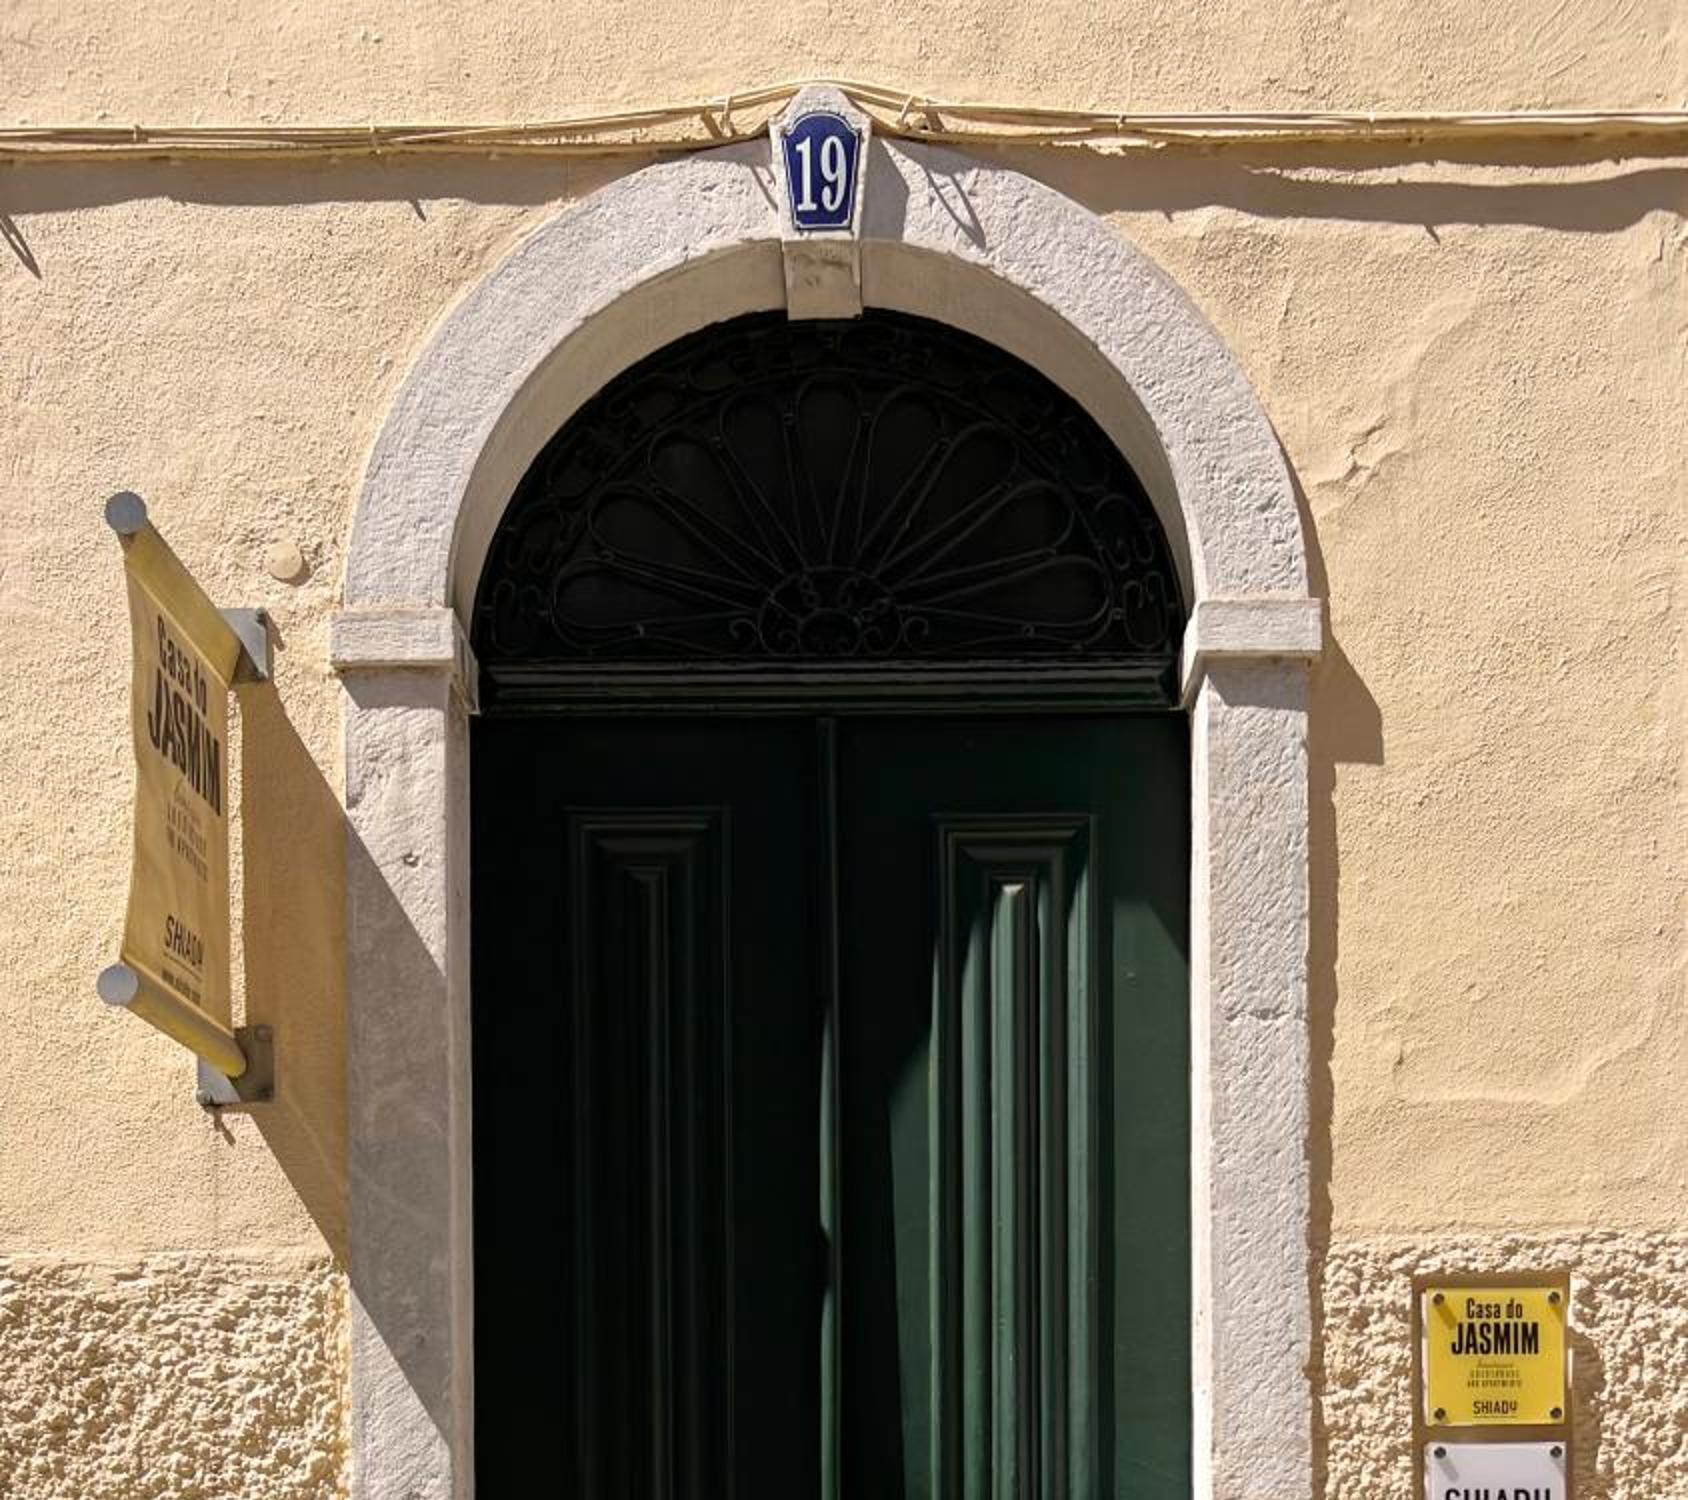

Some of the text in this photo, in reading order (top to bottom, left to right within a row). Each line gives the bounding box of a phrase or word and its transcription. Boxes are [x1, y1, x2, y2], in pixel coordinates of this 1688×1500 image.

[795, 135, 847, 212] 19
[158, 613, 192, 695] Casa
[148, 666, 221, 817] JASMIM
[1466, 1297, 1523, 1319] Casa do
[1451, 1322, 1539, 1355] JASMIM
[1473, 1400, 1518, 1414] SHIADU
